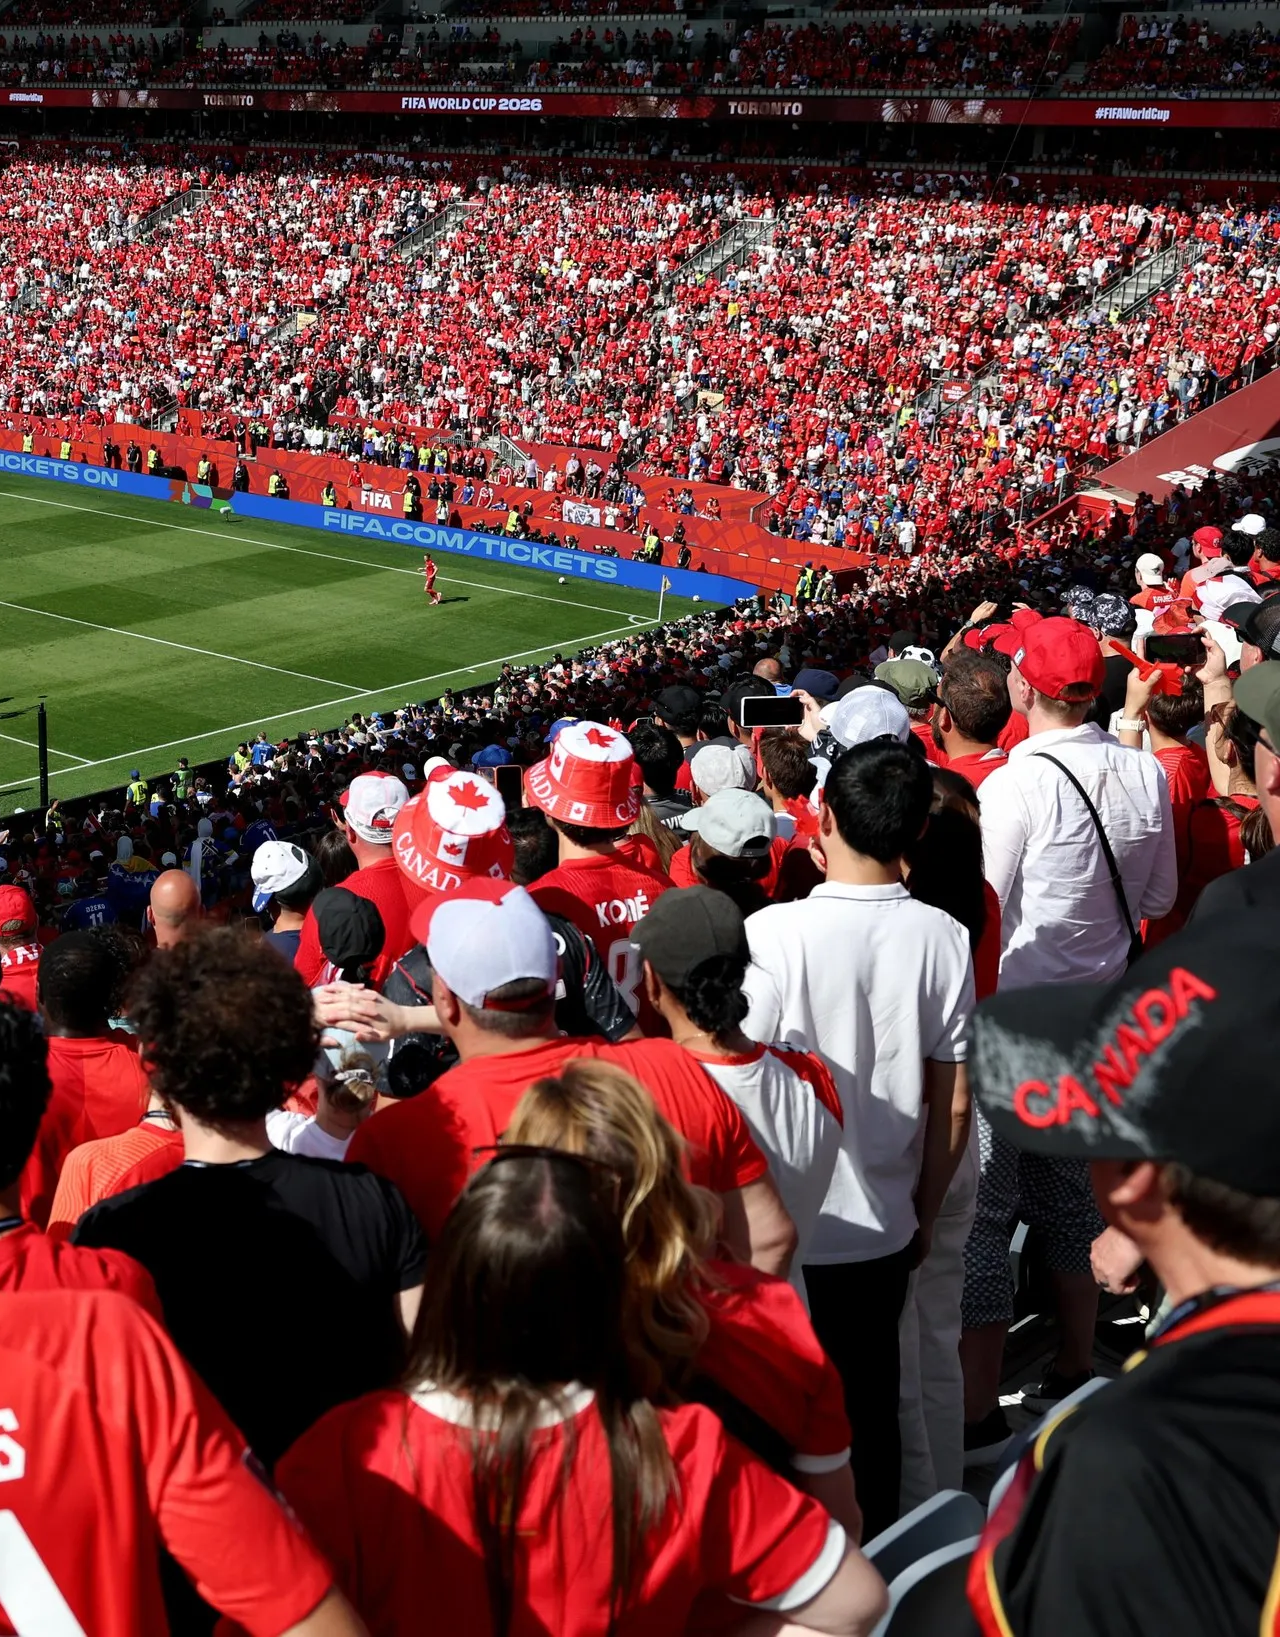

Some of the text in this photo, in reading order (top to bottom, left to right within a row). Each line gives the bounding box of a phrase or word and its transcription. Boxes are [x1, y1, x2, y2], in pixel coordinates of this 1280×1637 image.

[203, 94, 254, 107] TORONTO
[402, 97, 543, 111] FIFA WORLD CUP 2026
[728, 101, 803, 116] TORONTO
[1095, 106, 1170, 121] #FIFAWorldCup
[83, 468, 118, 487] ON
[361, 490, 392, 510] FIFA
[323, 511, 618, 579] FIFA.COM/TICKETS
[396, 832, 461, 892] CANAD
[1013, 966, 1216, 1129] CANADA
